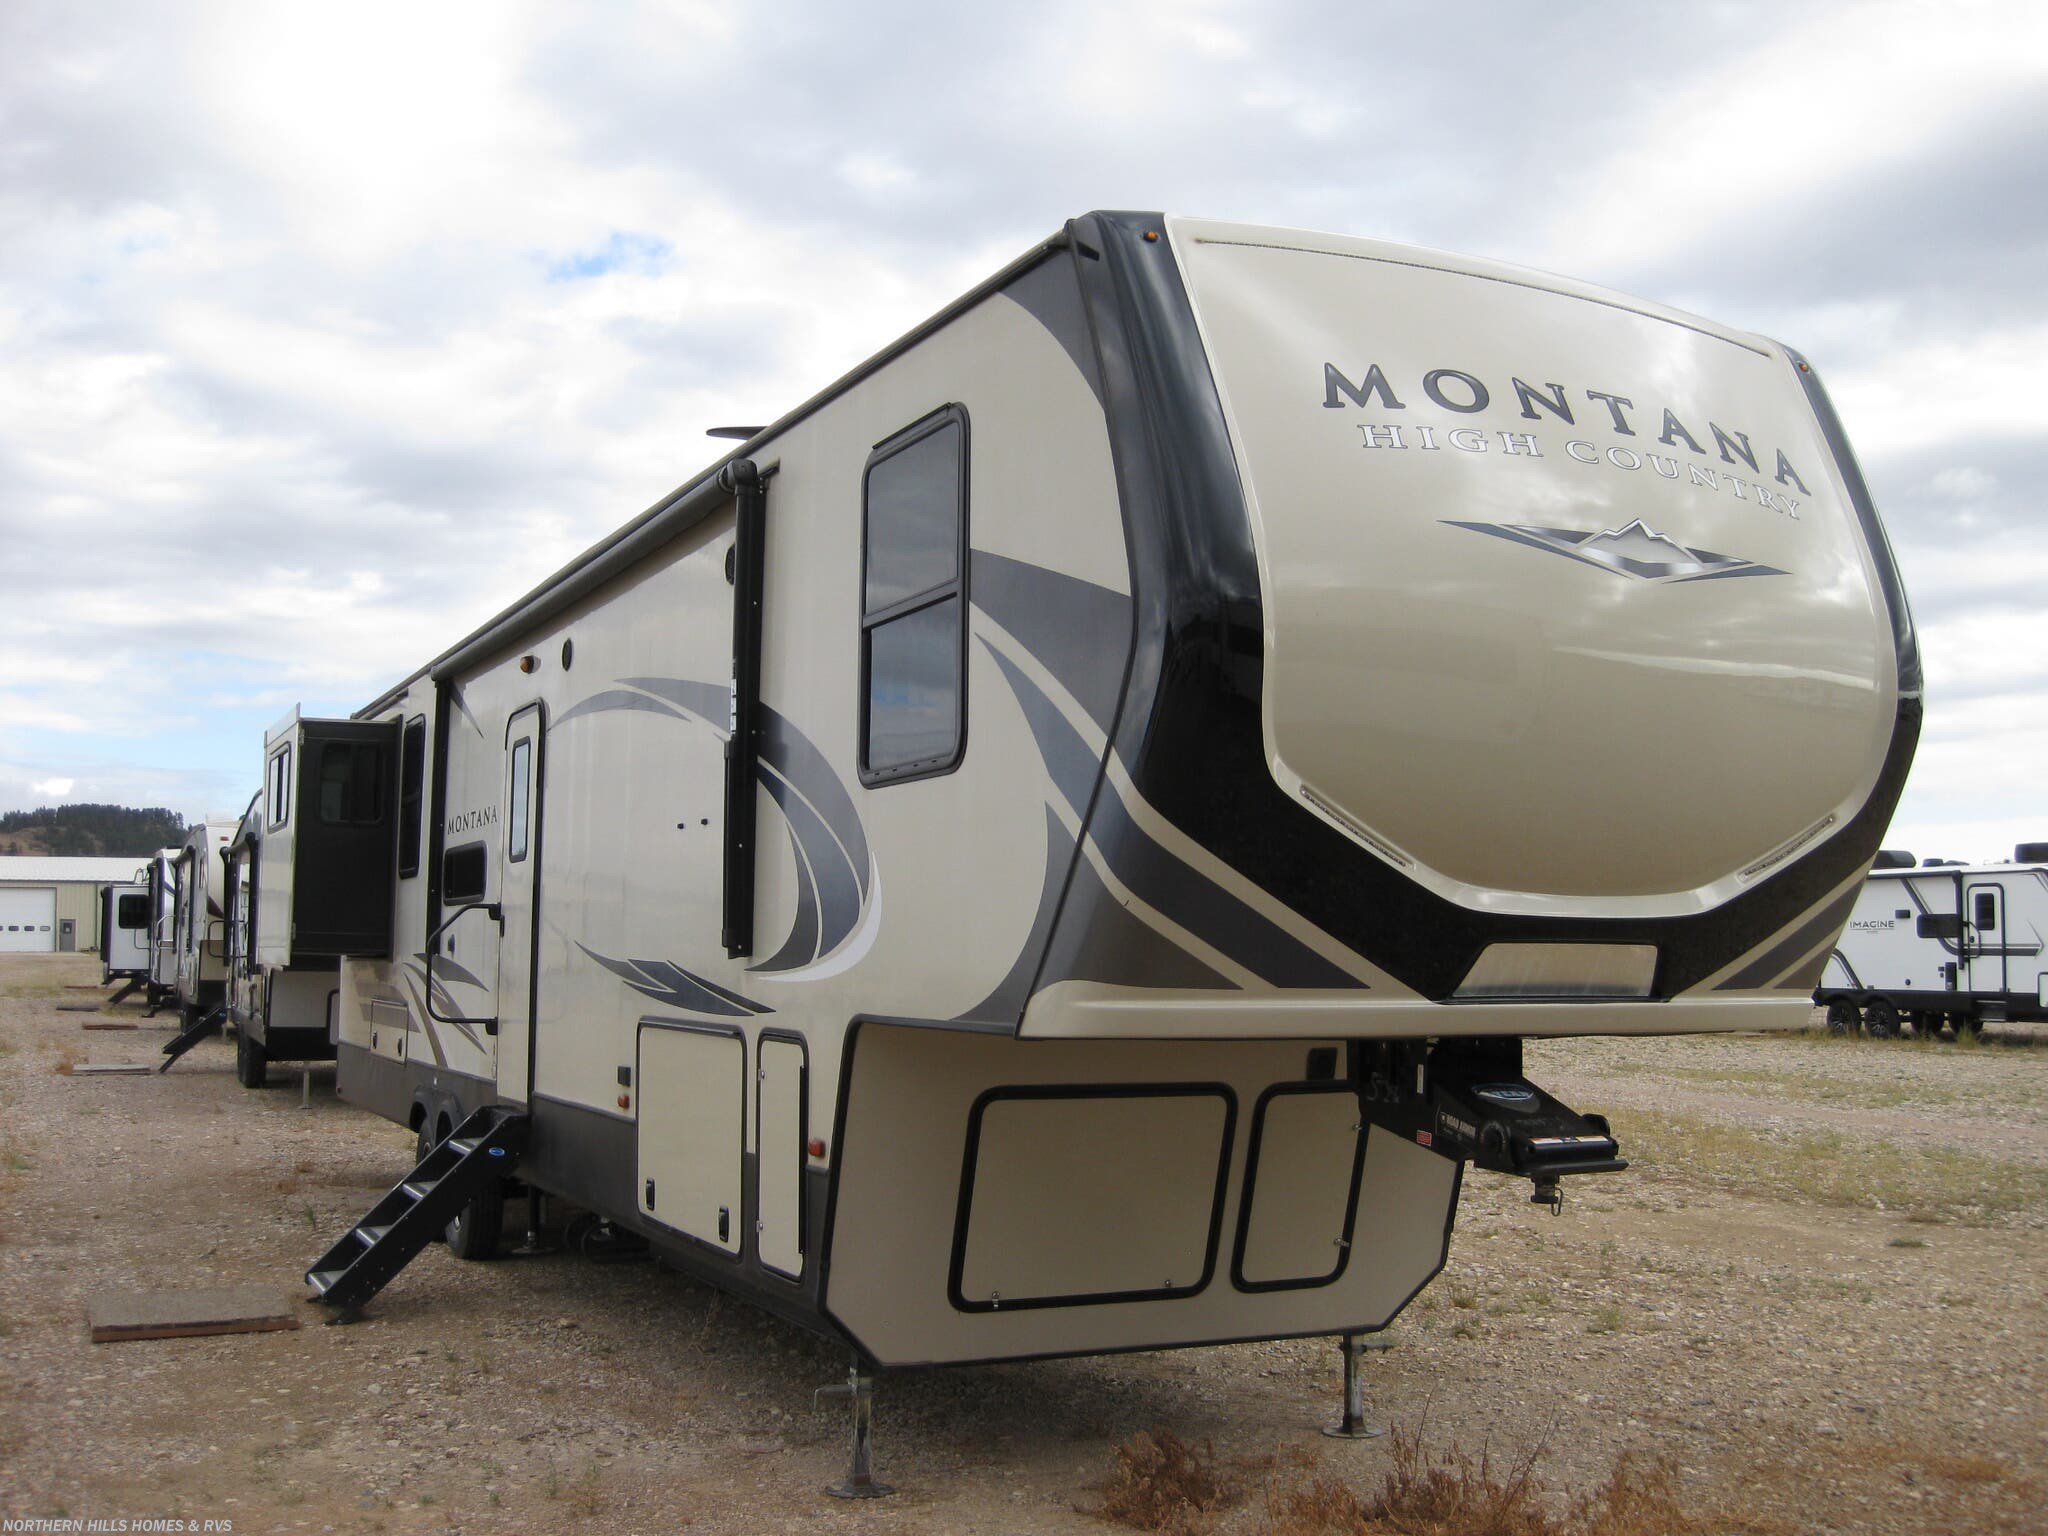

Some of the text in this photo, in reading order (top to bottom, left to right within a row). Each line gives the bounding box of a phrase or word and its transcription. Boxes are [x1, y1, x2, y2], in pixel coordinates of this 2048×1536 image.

[1322, 362, 1812, 497] MONTANA
[1356, 424, 1801, 521] HIGH COUNTRY
[447, 805, 498, 836] MONTANA
[1849, 920, 1895, 929] IMAGINE
